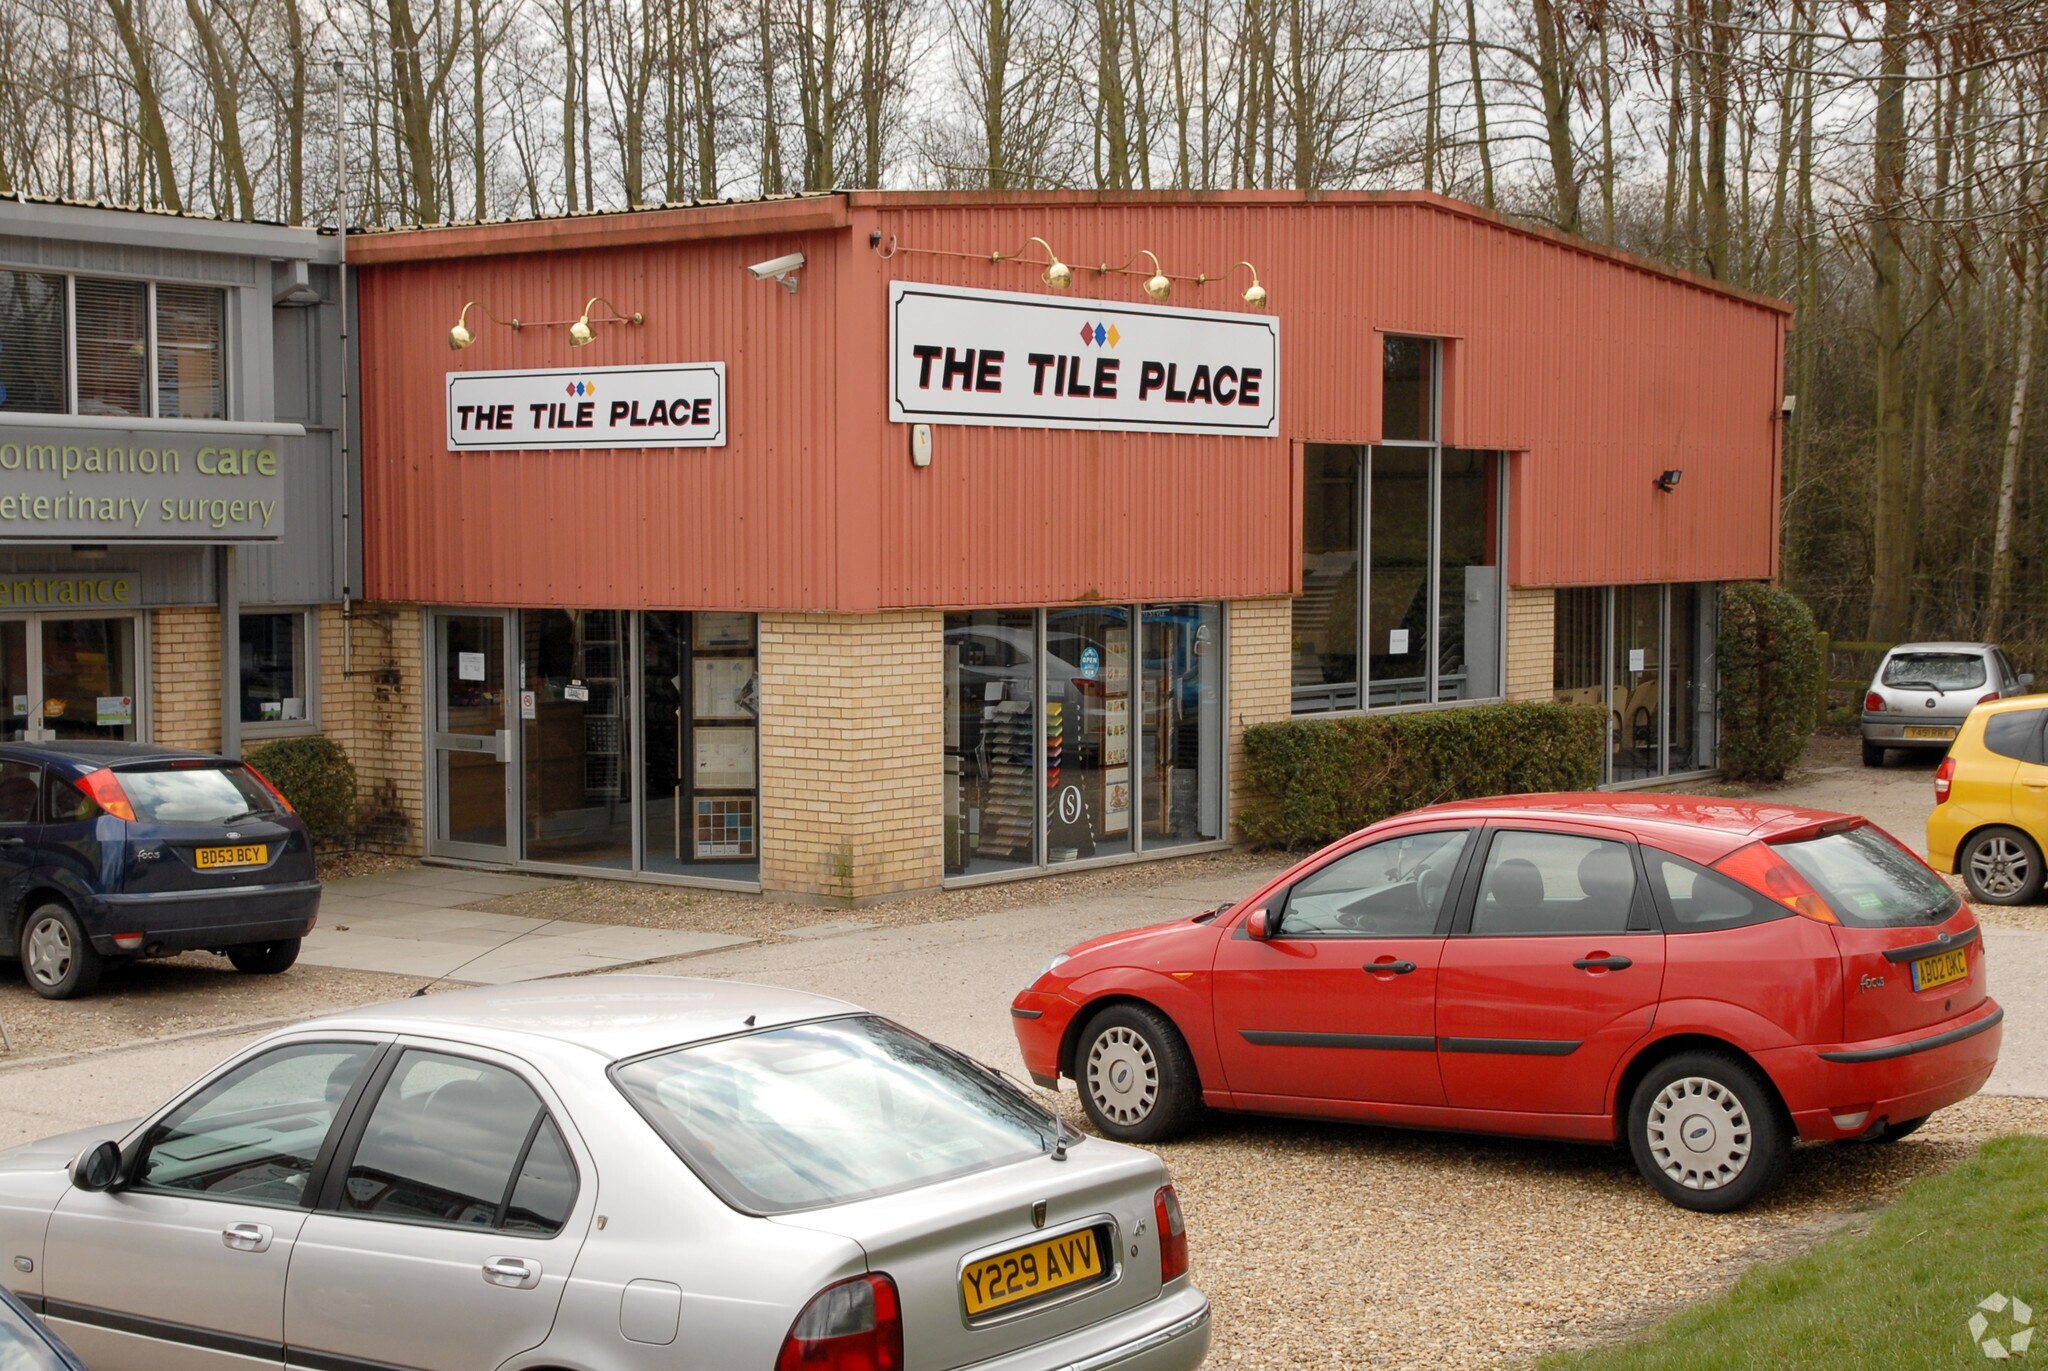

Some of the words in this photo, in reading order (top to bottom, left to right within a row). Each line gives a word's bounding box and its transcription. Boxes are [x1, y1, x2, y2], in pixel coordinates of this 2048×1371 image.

[913, 344, 1005, 393] THE
[1028, 353, 1120, 399] TILE
[1138, 360, 1262, 407] PLACE
[457, 404, 514, 430] THE
[530, 402, 595, 429] TILE
[609, 398, 712, 427] PLACE
[0, 442, 180, 480] ompanion
[196, 446, 277, 477] care
[0, 489, 150, 528] eterinary
[161, 497, 276, 529] surgery
[0, 577, 129, 603] entrance
[202, 849, 234, 865] BD53
[237, 847, 260, 862] BCY
[1920, 957, 1945, 985] AB02
[966, 1253, 1039, 1305] Y229
[1047, 1235, 1092, 1281] AVV
